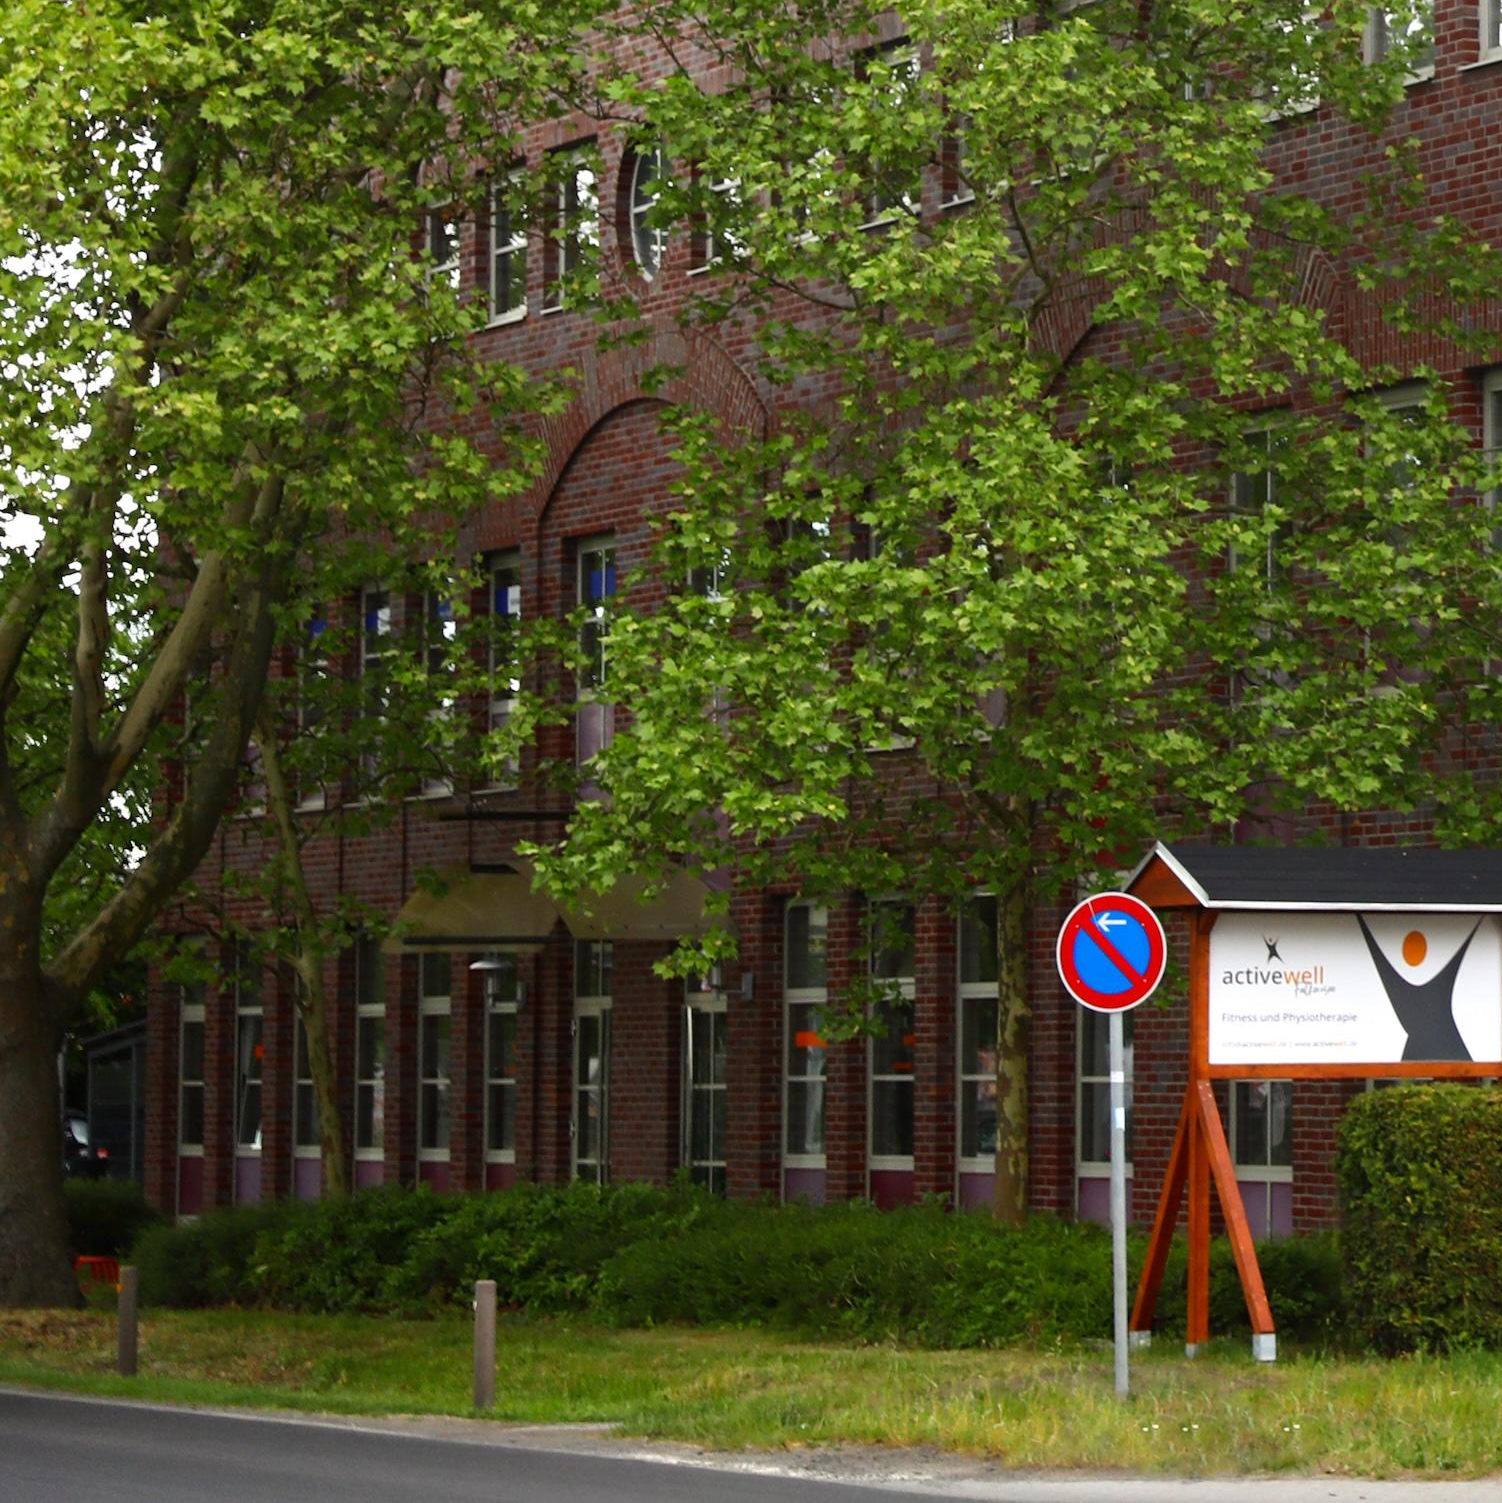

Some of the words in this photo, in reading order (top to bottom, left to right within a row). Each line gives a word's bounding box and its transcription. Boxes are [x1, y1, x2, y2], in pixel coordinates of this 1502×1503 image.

[1222, 966, 1324, 985] activewell
[1222, 1012, 1258, 1023] Fitness
[1260, 1012, 1280, 1023] und
[1282, 1012, 1358, 1024] Physiotherapie
